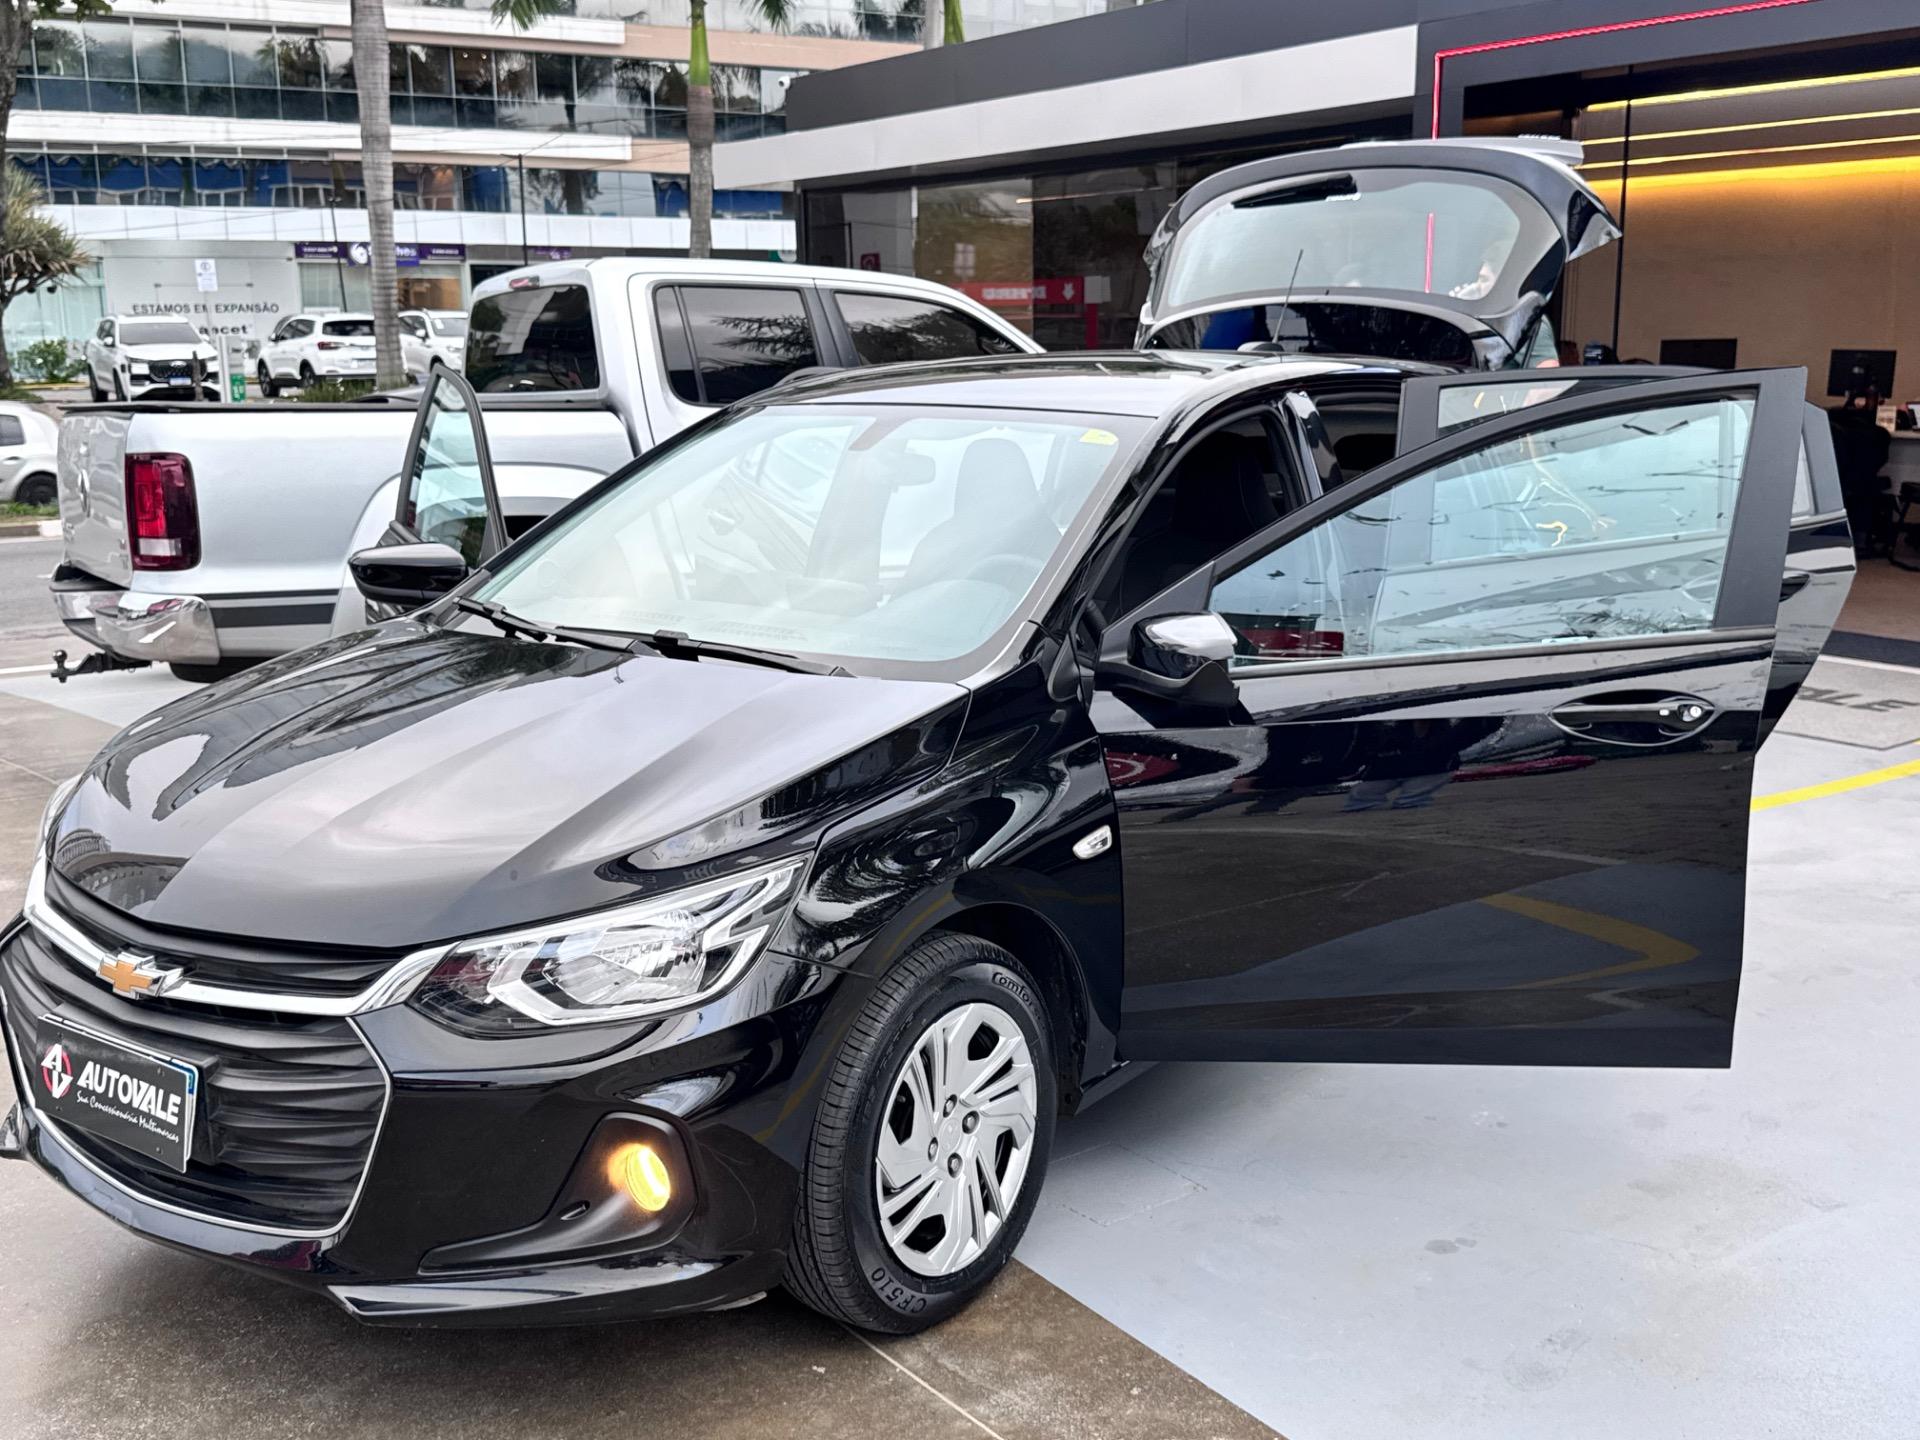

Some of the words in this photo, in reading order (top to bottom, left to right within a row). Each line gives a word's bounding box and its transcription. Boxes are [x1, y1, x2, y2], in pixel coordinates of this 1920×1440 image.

[132, 303, 191, 314] ESTAMOS
[215, 301, 280, 314] EXPANSÃO
[76, 1060, 182, 1126] AUTOVALE
[76, 1090, 89, 1104] Sua
[138, 1114, 179, 1143] Multimarcas
[871, 1267, 927, 1313] CF510
